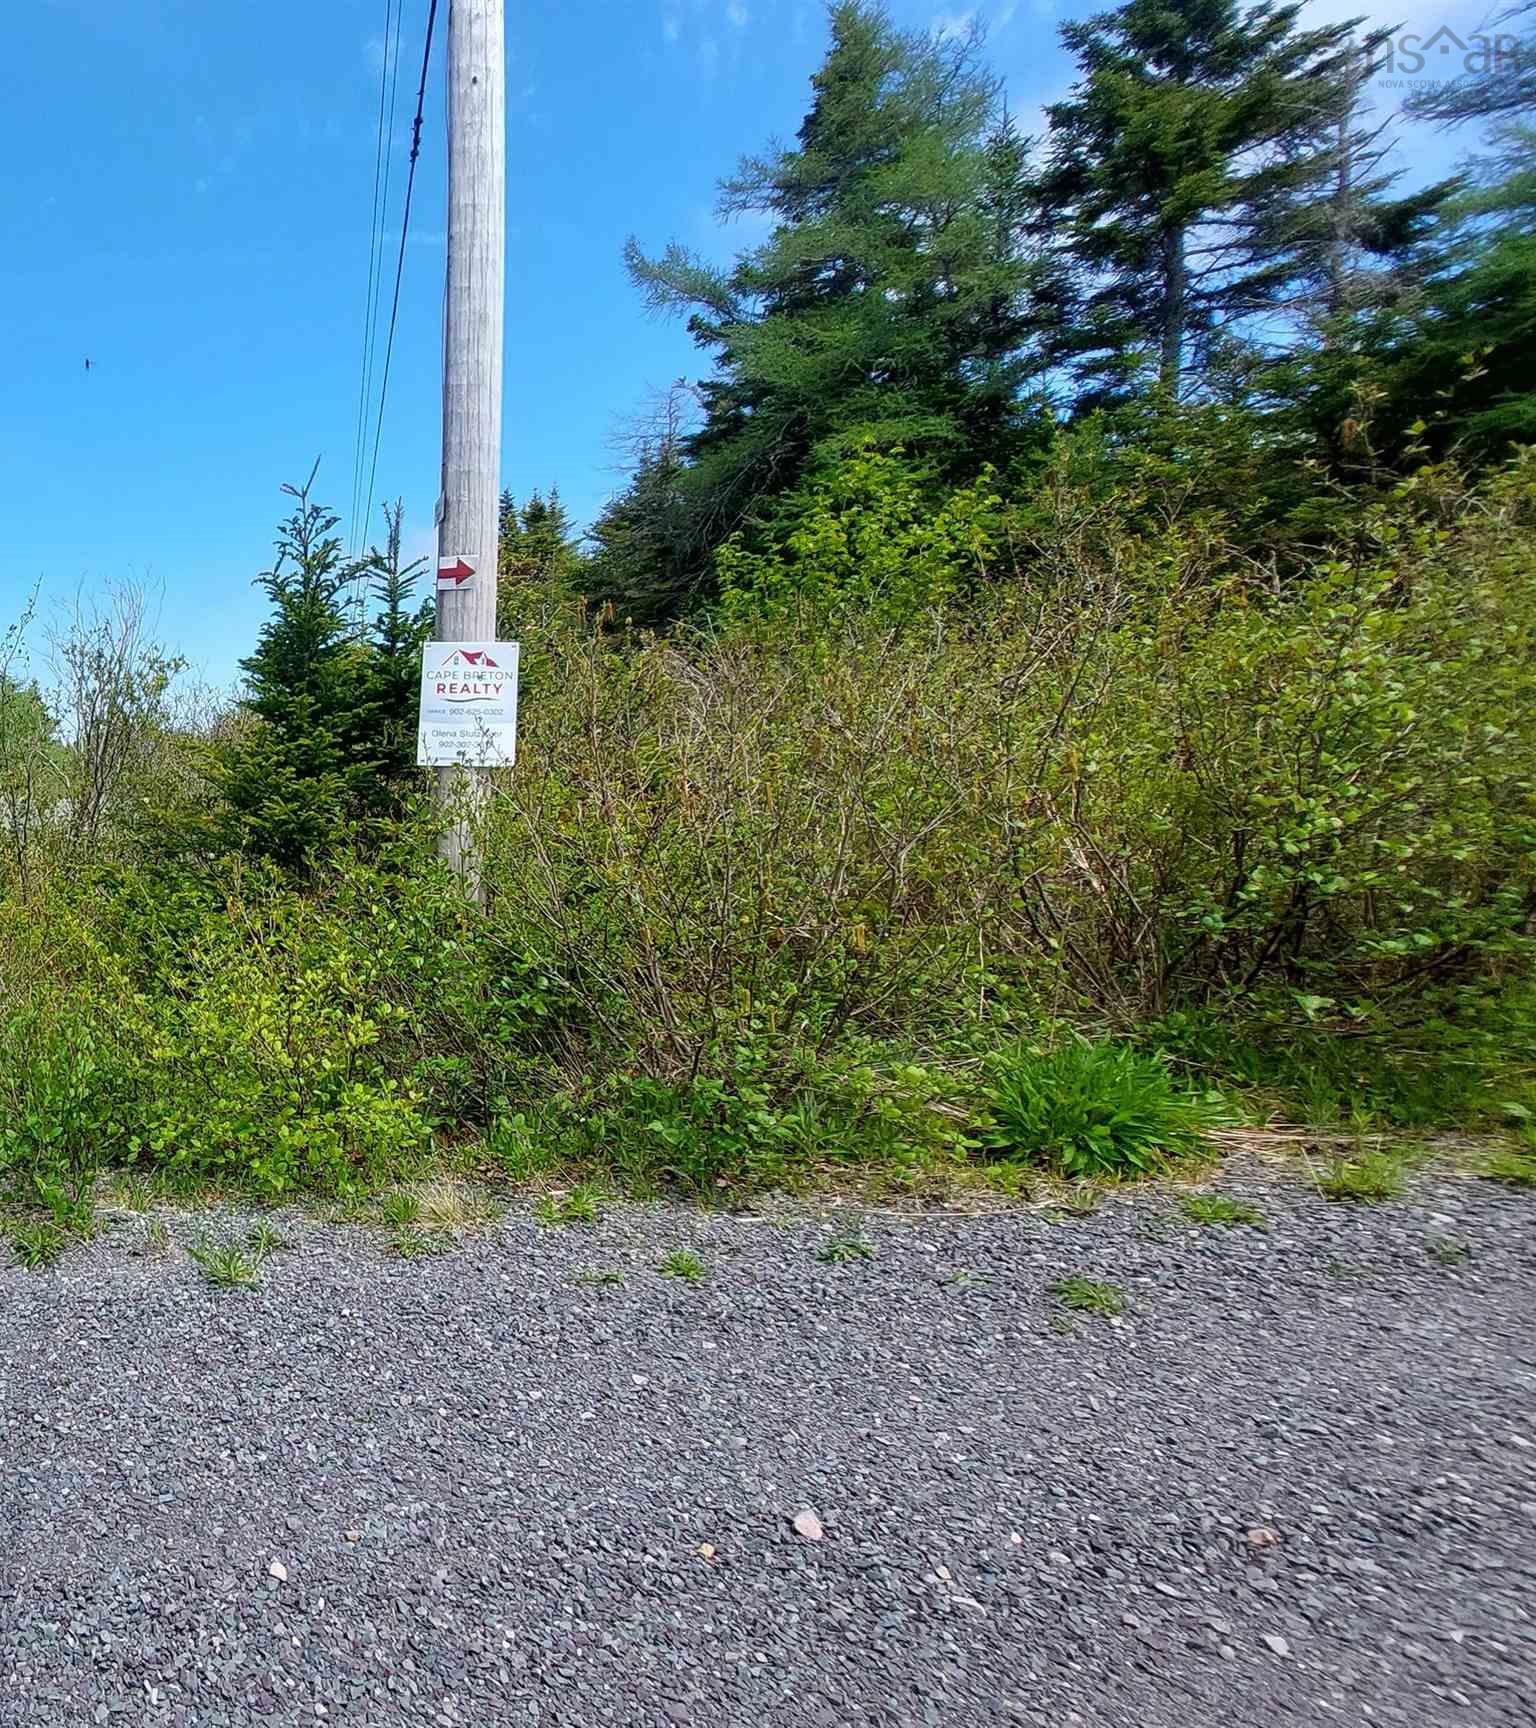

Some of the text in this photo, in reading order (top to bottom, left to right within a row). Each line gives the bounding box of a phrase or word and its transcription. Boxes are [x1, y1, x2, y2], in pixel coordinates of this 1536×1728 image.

[426, 671, 514, 681] CAPE BRETON
[437, 683, 504, 695] REALTY
